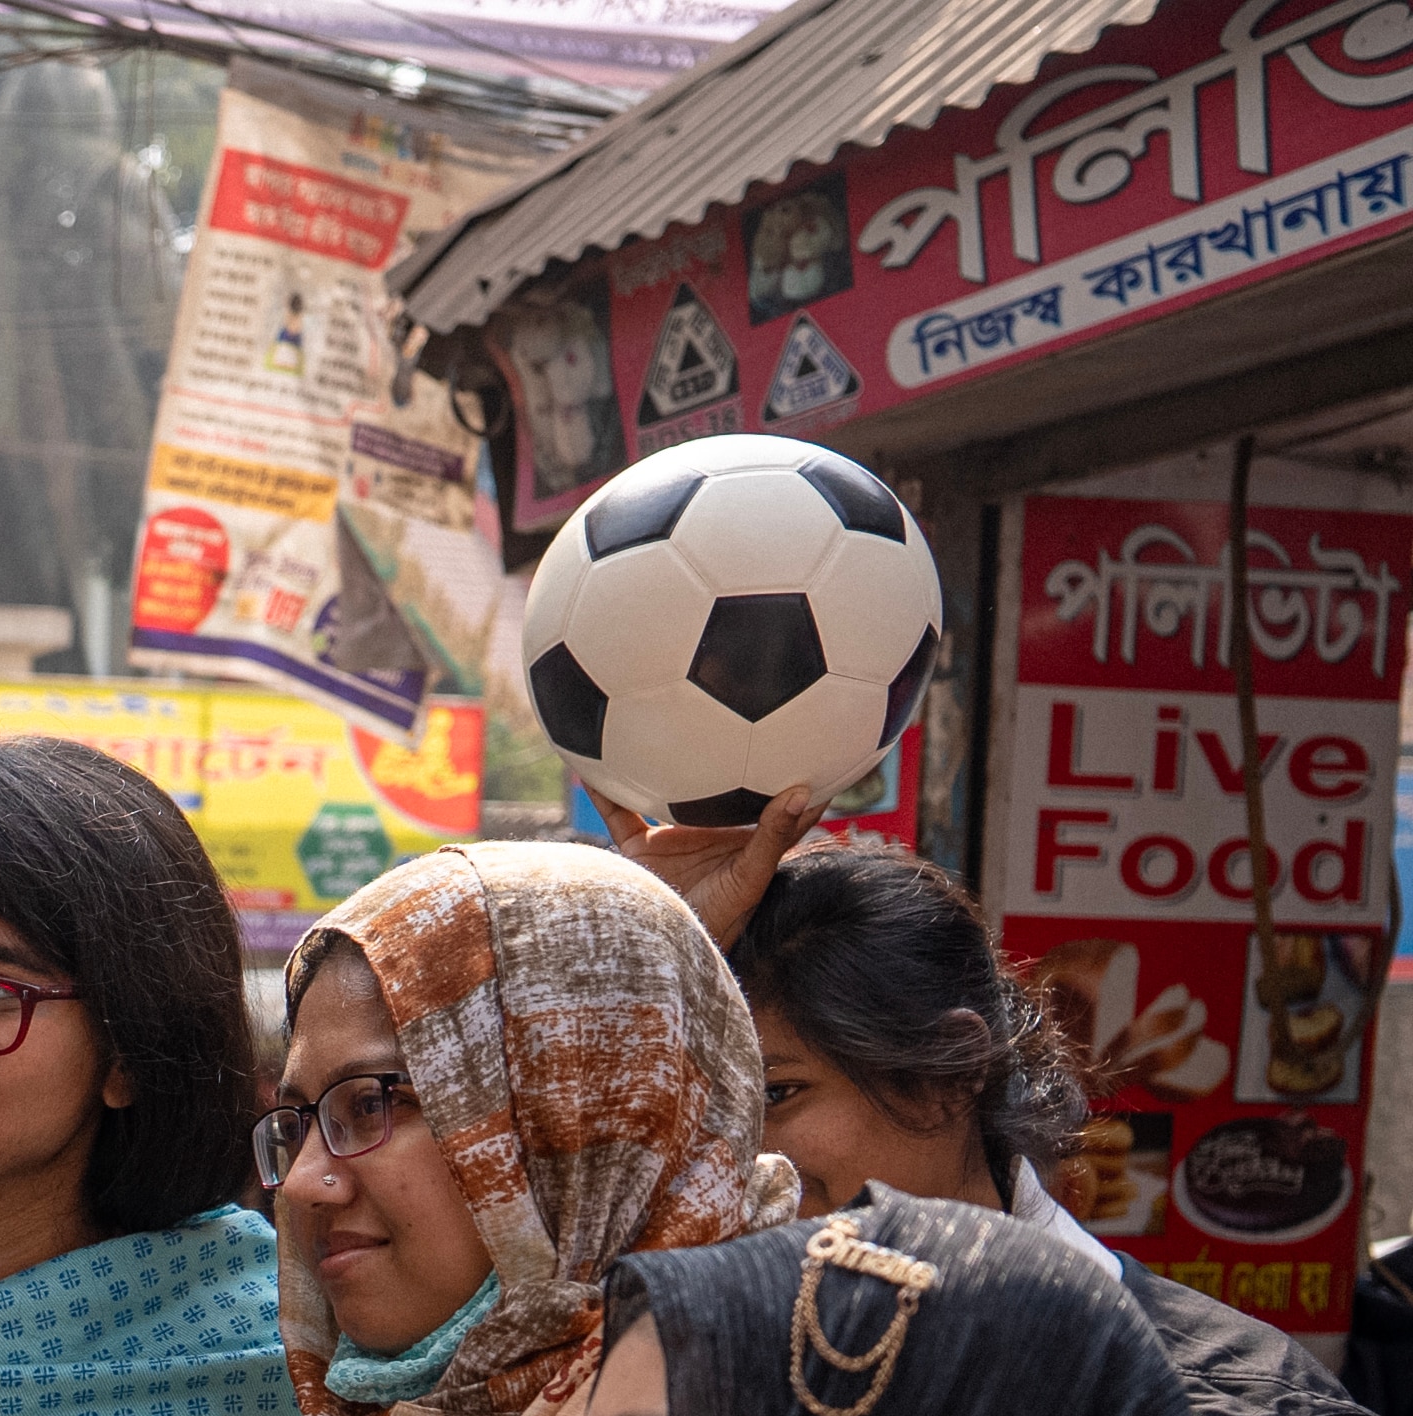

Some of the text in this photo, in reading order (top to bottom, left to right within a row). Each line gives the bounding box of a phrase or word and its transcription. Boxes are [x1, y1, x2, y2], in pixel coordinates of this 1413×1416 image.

[911, 285, 1064, 375] নিজস্ব
[1084, 152, 1413, 305] কারখানায়
[1044, 523, 1401, 679] পলিভিটা
[1046, 701, 1370, 803] Live
[1033, 808, 1368, 906] Food
